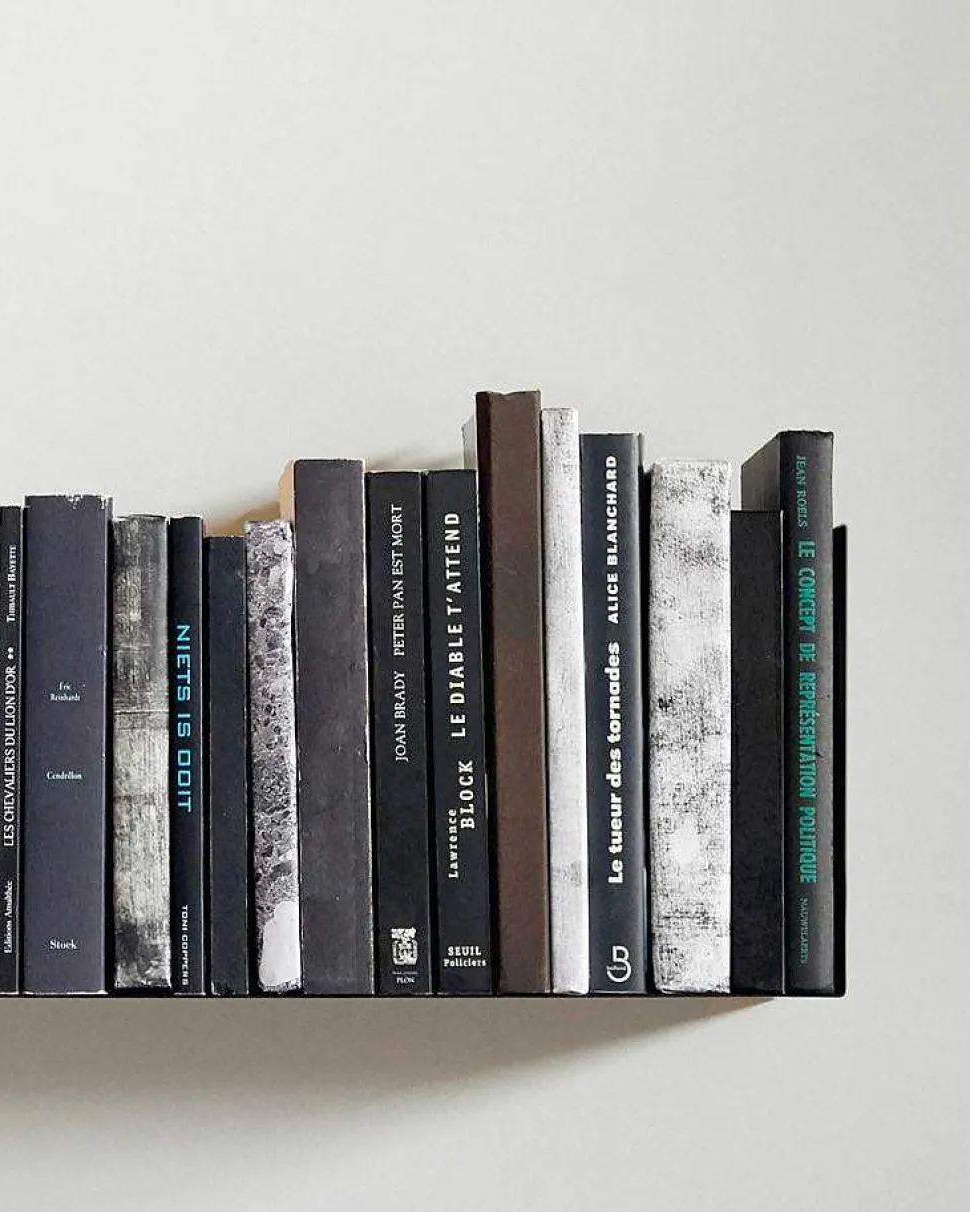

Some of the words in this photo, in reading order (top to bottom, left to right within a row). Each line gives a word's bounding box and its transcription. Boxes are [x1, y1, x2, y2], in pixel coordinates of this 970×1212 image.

[795, 454, 807, 485] JEAN
[390, 503, 403, 547] MORT
[605, 455, 618, 566] BLANCHARD
[391, 549, 404, 575] EST
[444, 512, 462, 616] T'ATTEND
[798, 540, 817, 559] LE
[392, 580, 405, 610] PAN
[606, 572, 619, 624] ALICE
[798, 566, 817, 634] CONCEPT
[392, 613, 405, 656] PETER
[798, 642, 817, 661] DE
[5, 665, 16, 695] D'OR
[177, 624, 191, 701] NIETS
[448, 623, 465, 704] DIABLE
[5, 696, 16, 726] LION
[393, 670, 406, 719] BRADY
[604, 641, 621, 744] tornades
[5, 727, 16, 746] DU
[177, 712, 191, 738] IS
[393, 723, 409, 761] JOAN
[450, 713, 466, 738] LE
[4, 749, 16, 823] CHEVALIERS
[177, 749, 191, 813] OOIT
[606, 747, 622, 788] des
[458, 760, 475, 829] BLOCK
[4, 824, 15, 847] LES
[447, 808, 458, 879] Lawrence
[608, 792, 623, 854] tueur
[798, 806, 817, 884] POLITIQUE
[608, 859, 623, 884] Le
[50, 938, 78, 951] Stock
[443, 957, 487, 967] Policiers
[447, 945, 482, 957] SEUIL
